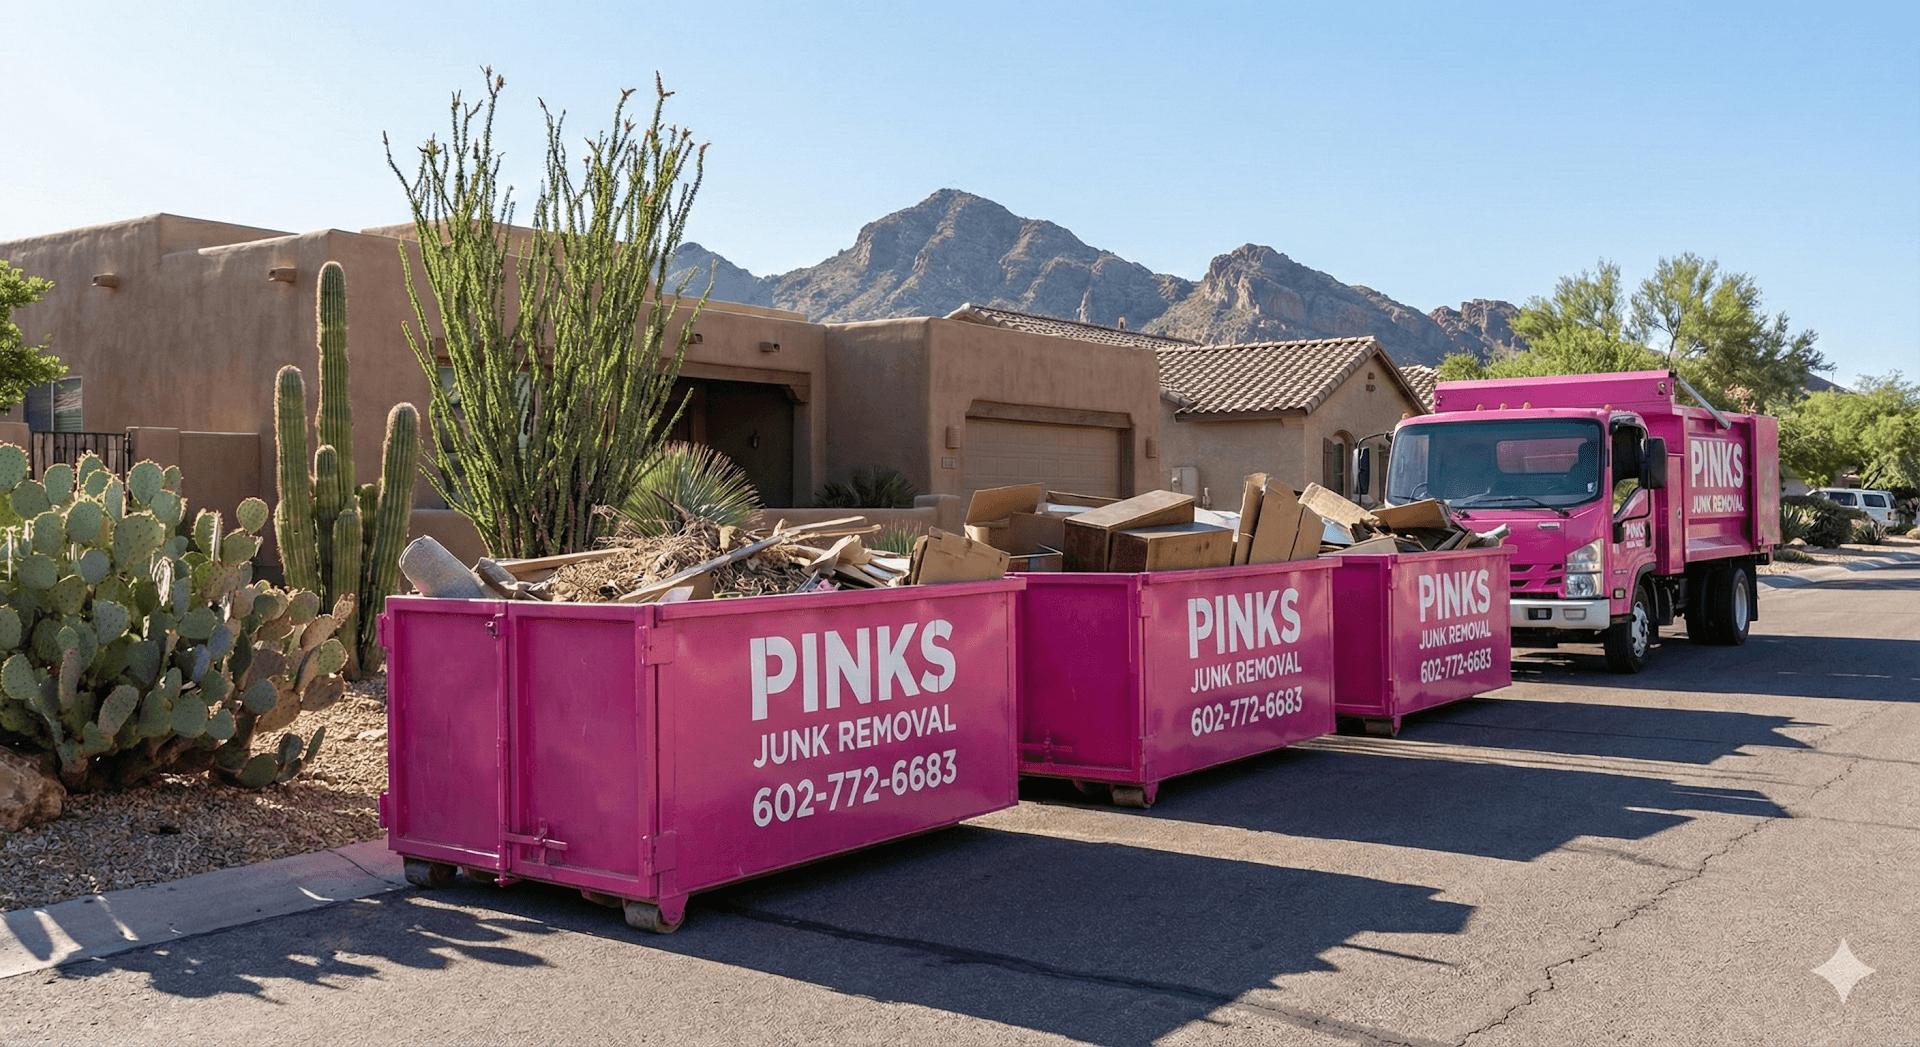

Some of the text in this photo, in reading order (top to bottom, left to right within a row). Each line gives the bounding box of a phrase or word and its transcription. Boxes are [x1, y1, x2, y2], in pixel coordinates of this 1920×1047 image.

[1691, 440, 1744, 488] PINKS
[1692, 495, 1712, 514] JUNK
[1418, 569, 1491, 622] PINKS
[1187, 587, 1301, 659] PINKS
[1419, 619, 1492, 650] JUNK REMOVAL
[750, 619, 956, 721] PINKS
[1190, 651, 1302, 693] JUNK REMOVAL
[1420, 647, 1492, 684] 602-772-6683
[753, 704, 957, 768] JUNK REMOVAL
[1191, 686, 1303, 737] 602-772-6683
[753, 749, 957, 828] 602-772-6683
